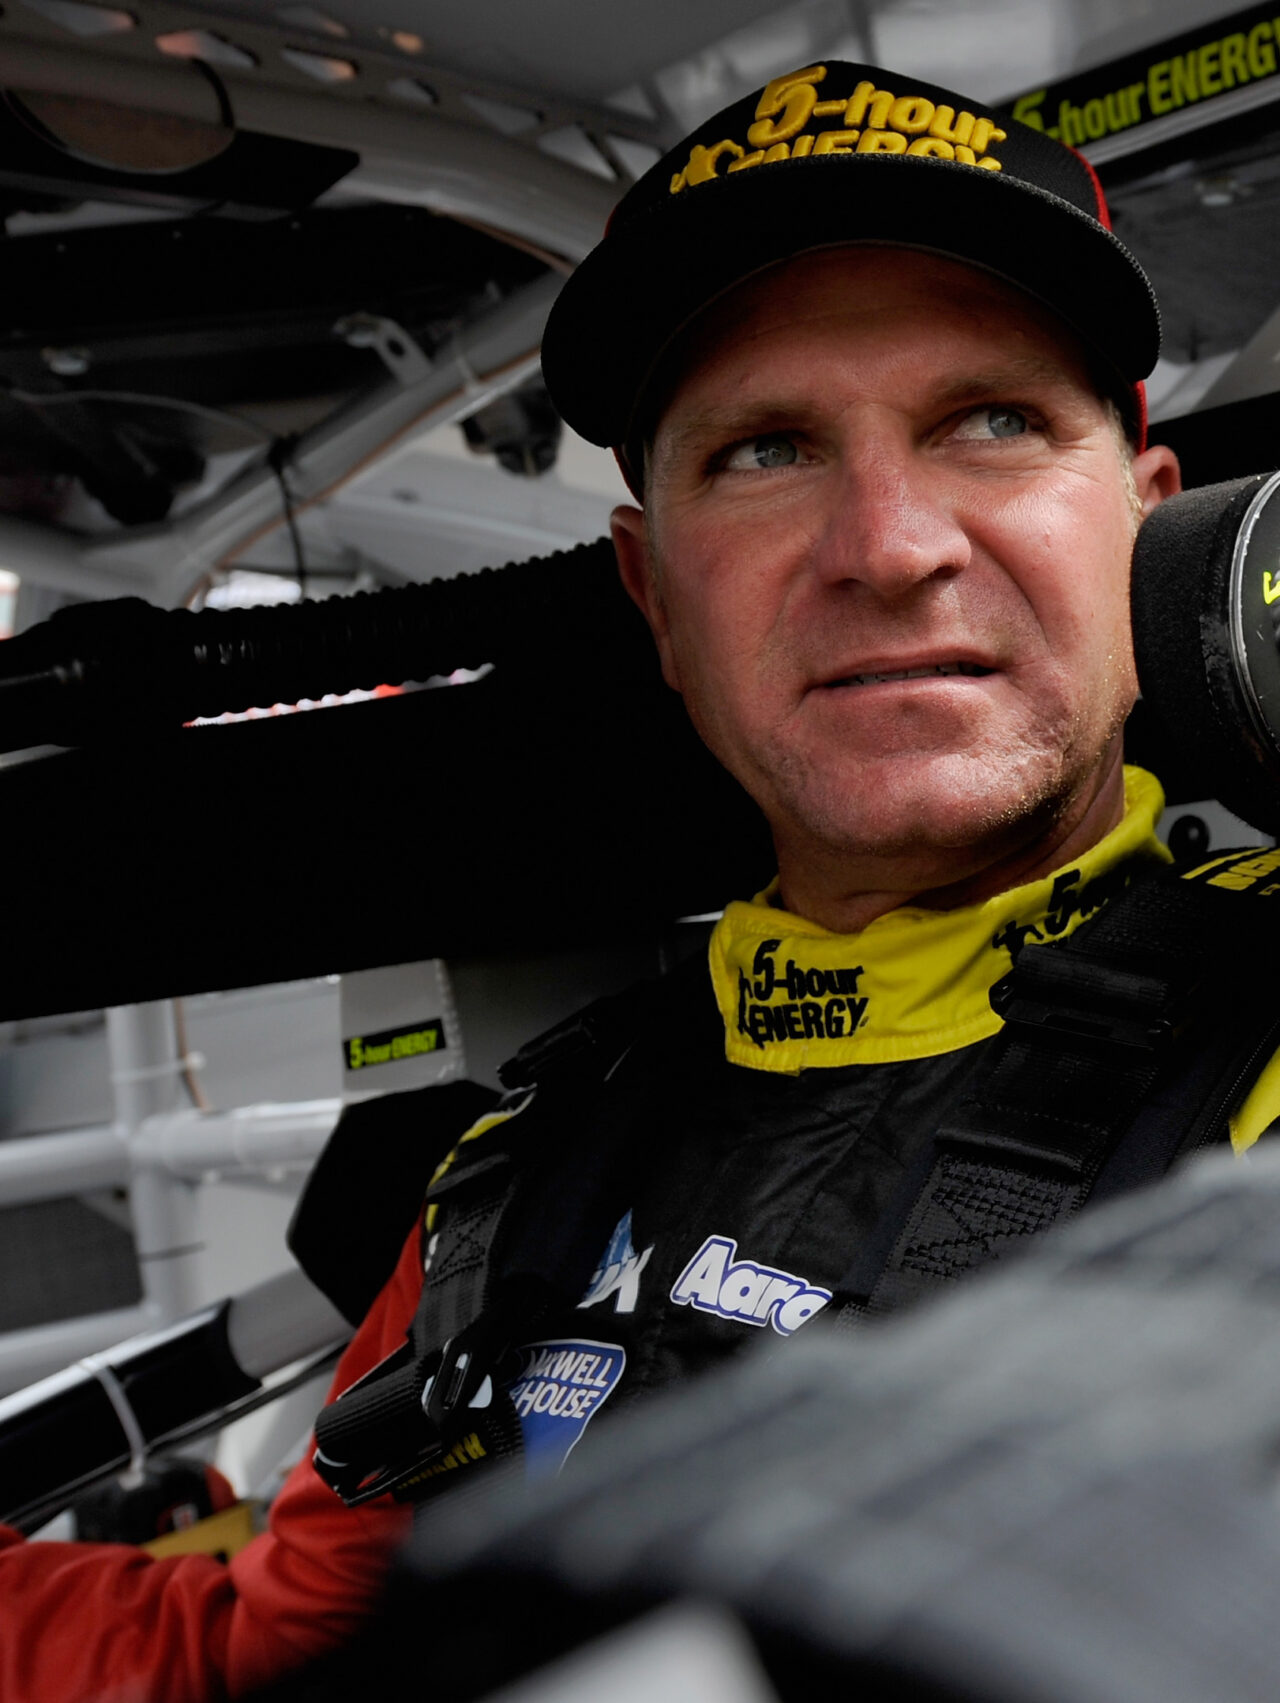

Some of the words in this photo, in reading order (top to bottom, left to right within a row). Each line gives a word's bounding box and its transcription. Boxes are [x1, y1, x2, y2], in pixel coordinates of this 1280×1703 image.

[747, 65, 1007, 153] 5-hour
[753, 939, 864, 1001] 5-hour
[748, 998, 869, 1043] ENERGY
[515, 1381, 600, 1418] HOUSE
